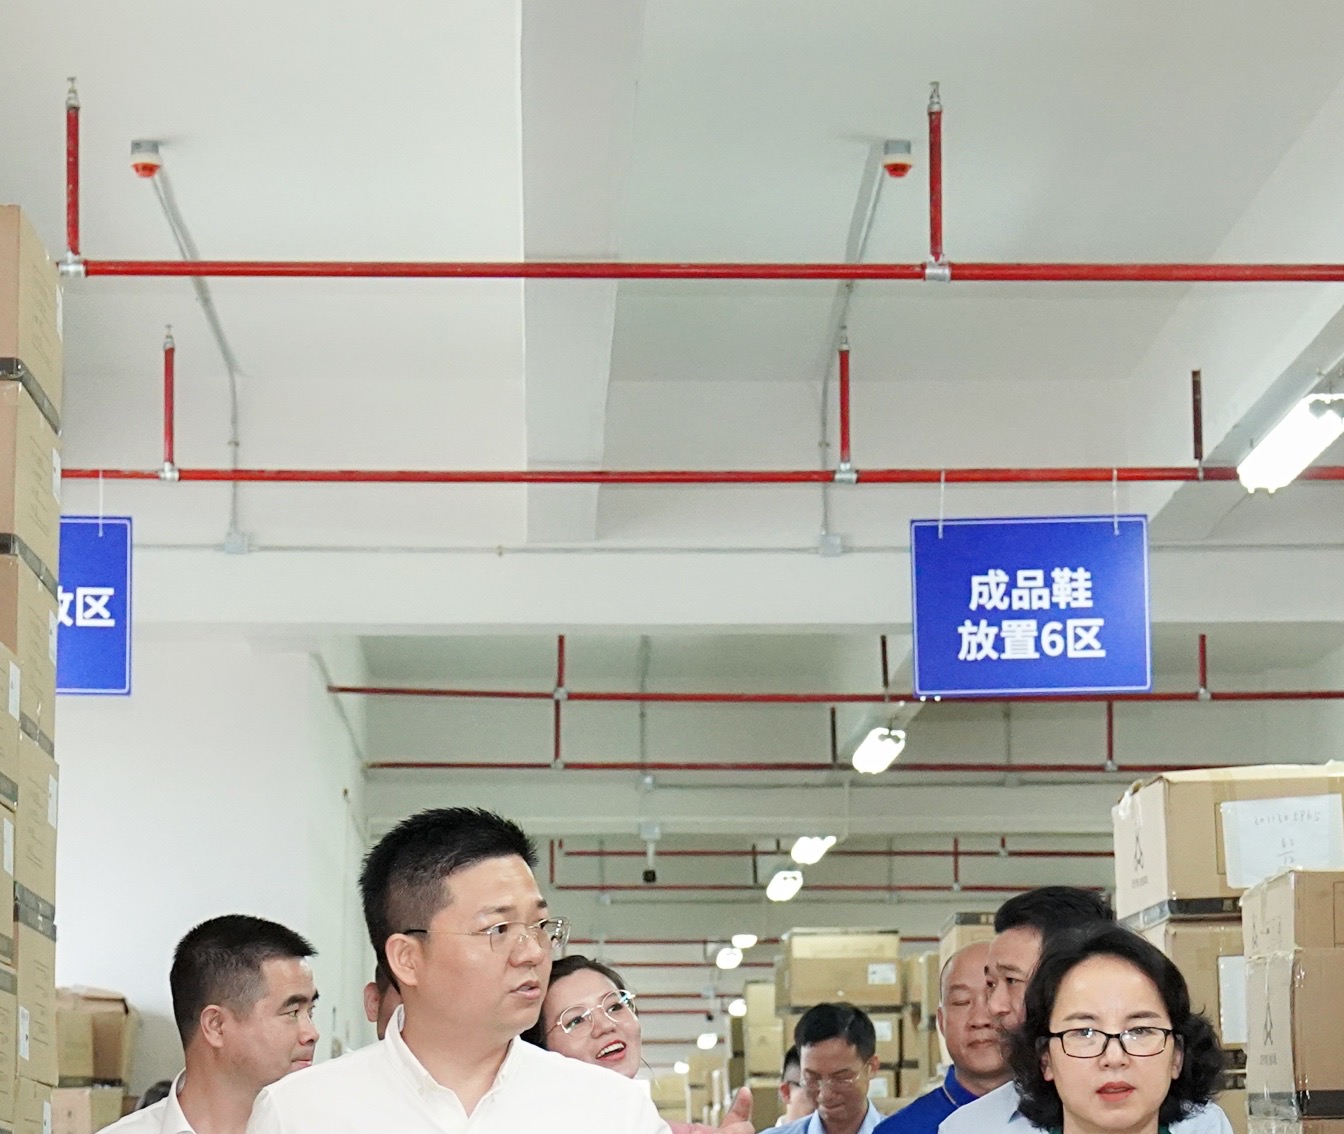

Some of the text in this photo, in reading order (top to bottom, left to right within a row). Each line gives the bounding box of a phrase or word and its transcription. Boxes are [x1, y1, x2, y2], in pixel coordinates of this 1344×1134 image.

[969, 567, 1093, 611] 成品鞋
[957, 618, 1106, 661] 放置6区
